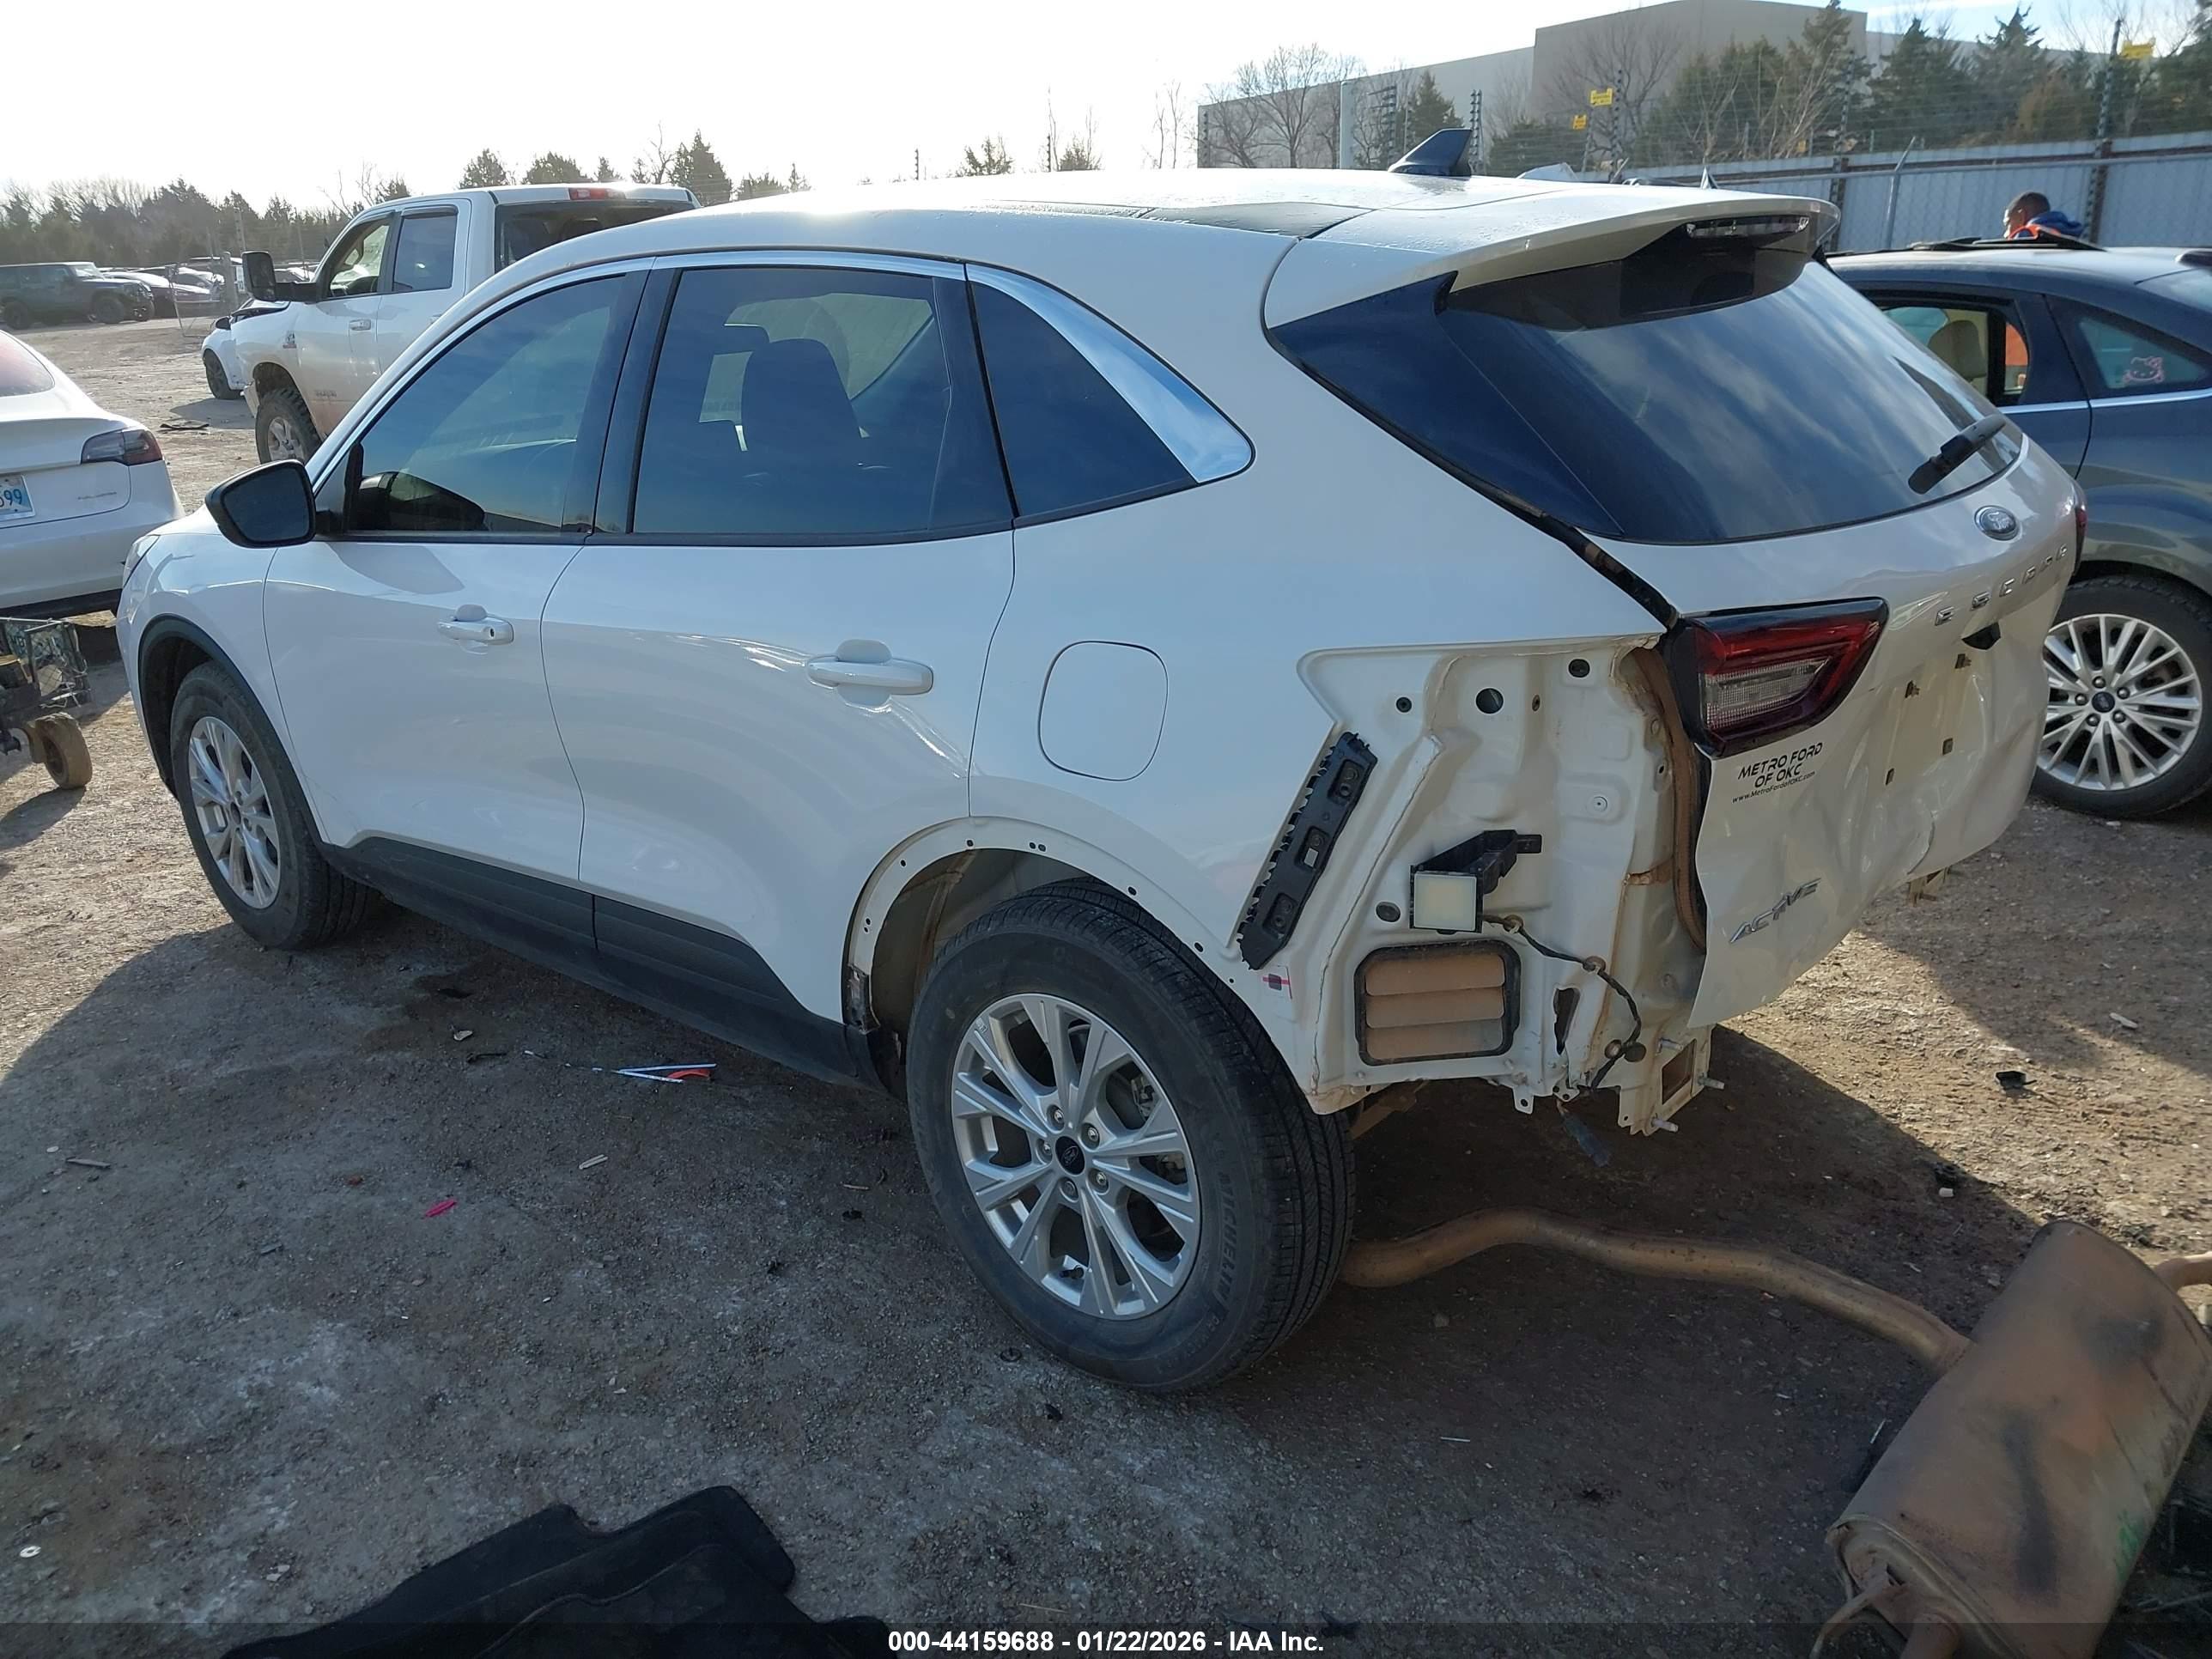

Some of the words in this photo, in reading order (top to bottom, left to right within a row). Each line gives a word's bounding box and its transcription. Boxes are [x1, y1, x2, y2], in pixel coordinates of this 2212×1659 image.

[1738, 754, 1787, 780] METRO
[1790, 743, 1823, 764] FORD
[1755, 773, 1773, 787] OF
[1777, 763, 1802, 781] OKC
[1729, 878, 1821, 944] ACTIVE
